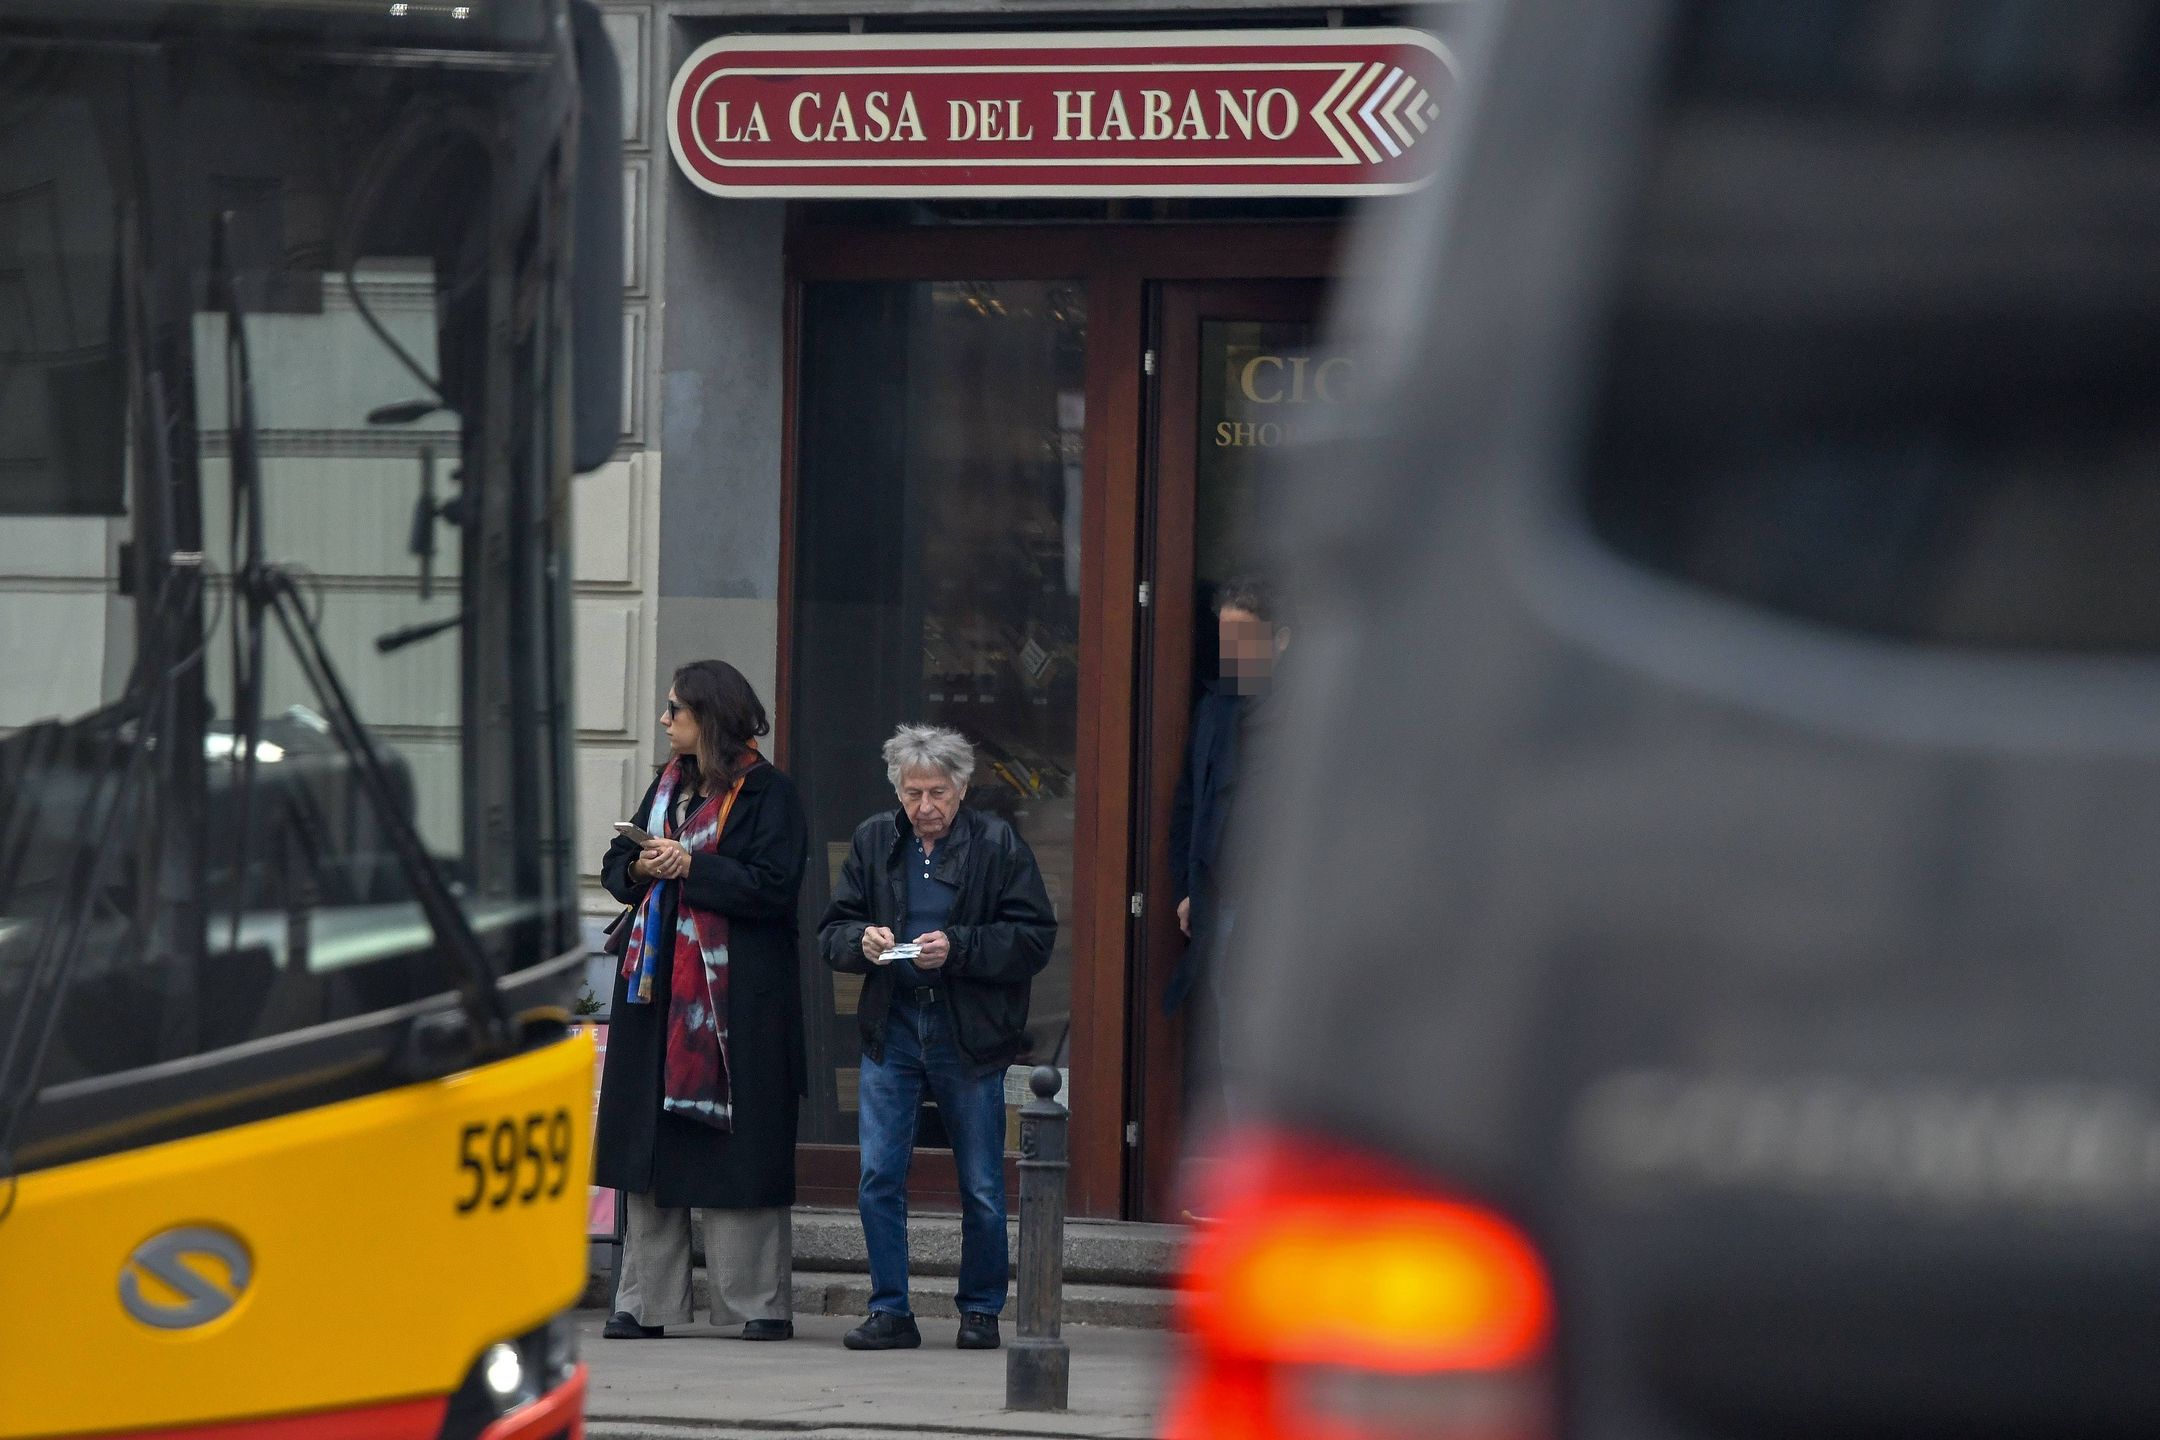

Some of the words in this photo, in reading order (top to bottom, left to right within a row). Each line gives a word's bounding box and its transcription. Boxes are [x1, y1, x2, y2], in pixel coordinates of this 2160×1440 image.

[715, 101, 770, 143] LA
[788, 91, 927, 142] CASA
[946, 99, 1033, 141] DEL
[1052, 87, 1299, 142] HABANO
[455, 1106, 573, 1218] 5959
